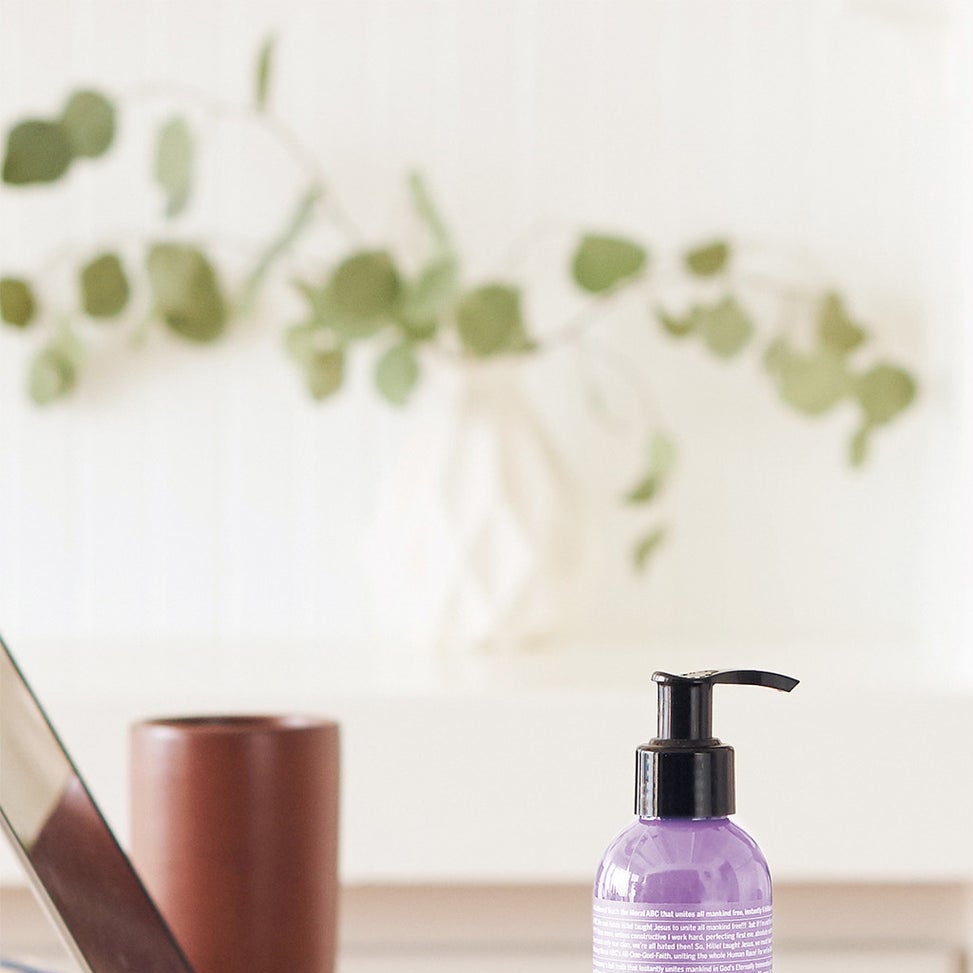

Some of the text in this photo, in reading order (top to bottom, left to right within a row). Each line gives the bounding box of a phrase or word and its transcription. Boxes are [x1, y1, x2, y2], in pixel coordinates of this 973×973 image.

[706, 933, 736, 942] perfecting
[722, 942, 741, 950] taught
[674, 952, 696, 961] uniting
[709, 952, 726, 960] whole
[727, 950, 746, 958] Human
